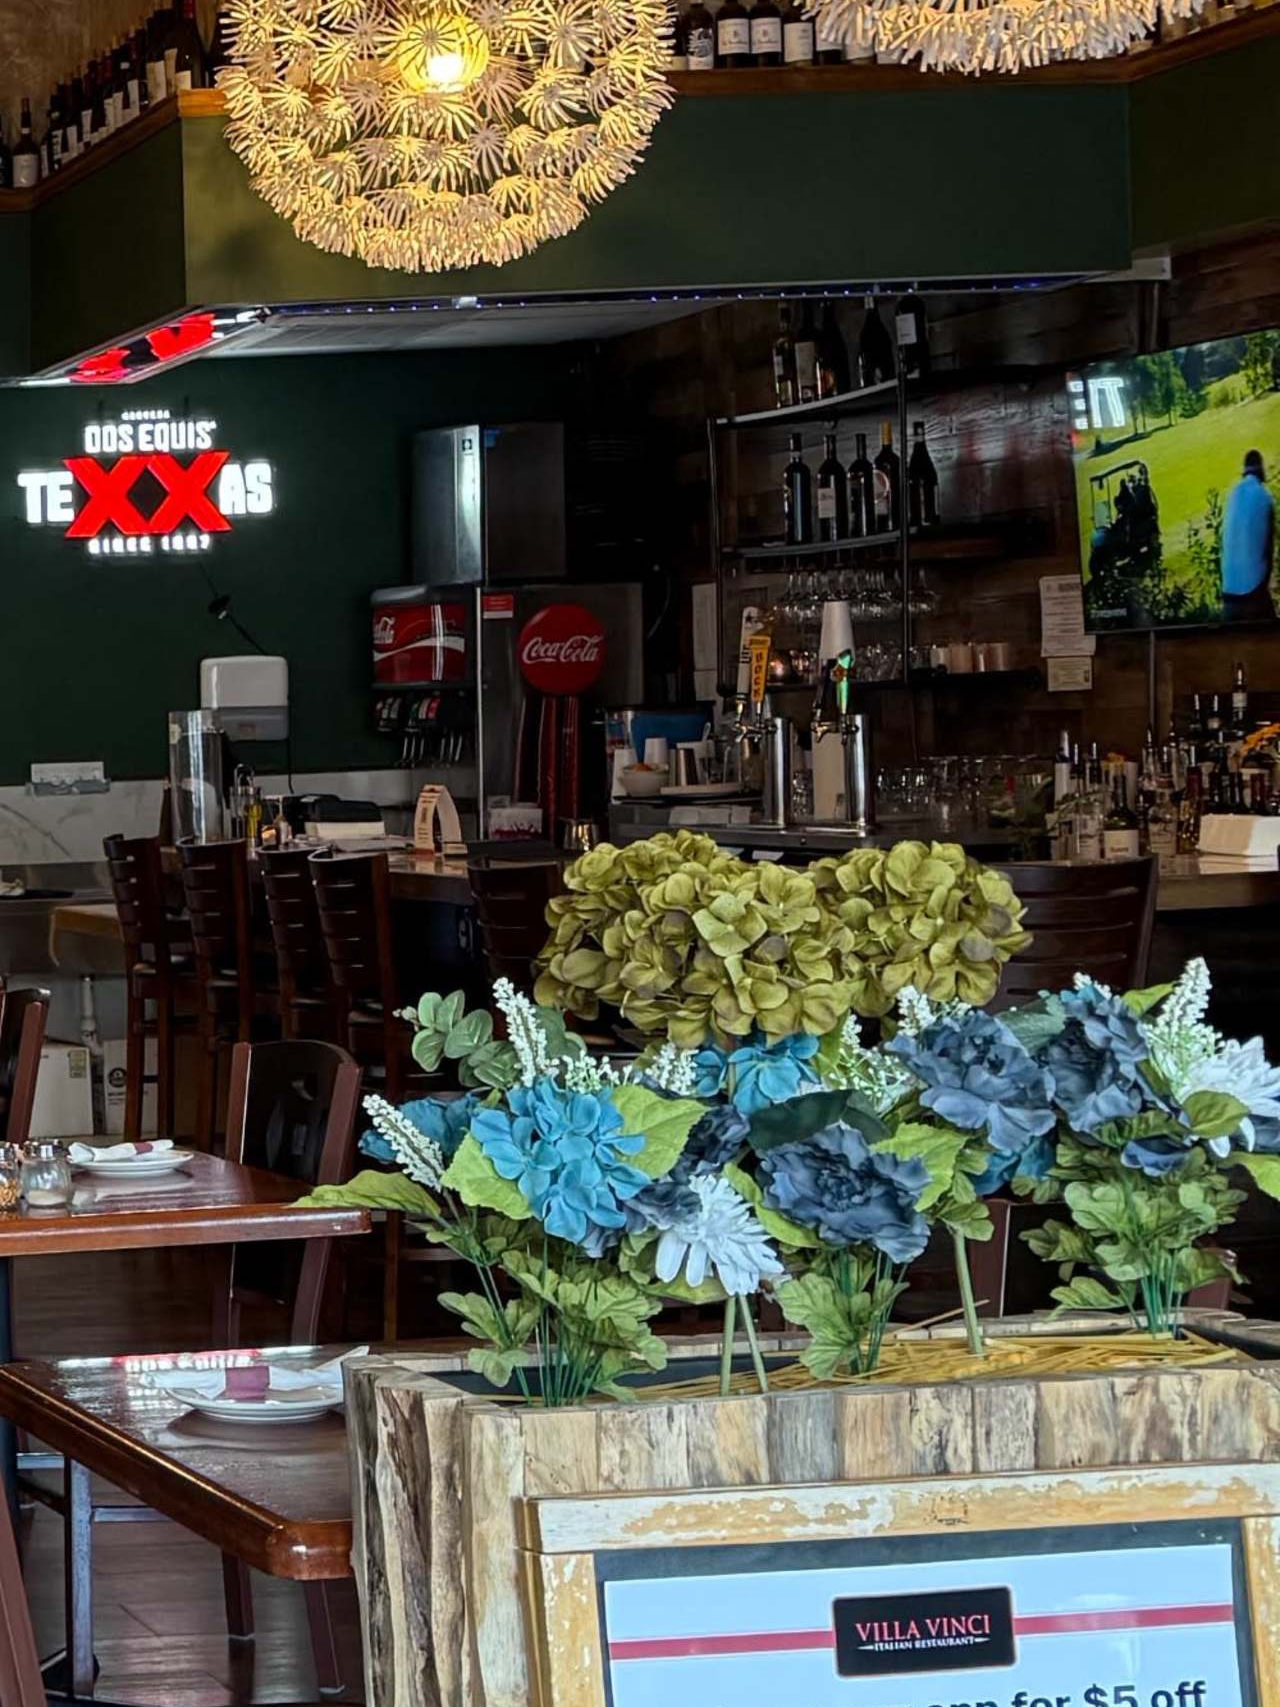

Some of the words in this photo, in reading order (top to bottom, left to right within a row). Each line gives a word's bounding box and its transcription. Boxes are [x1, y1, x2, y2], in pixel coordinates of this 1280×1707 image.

[84, 424, 134, 453] DOS
[856, 1620, 920, 1642] VILLA
[926, 1615, 990, 1636] VINCI
[875, 1641, 912, 1652] ITALIAN
[915, 1636, 975, 1649] RESTAURANT
